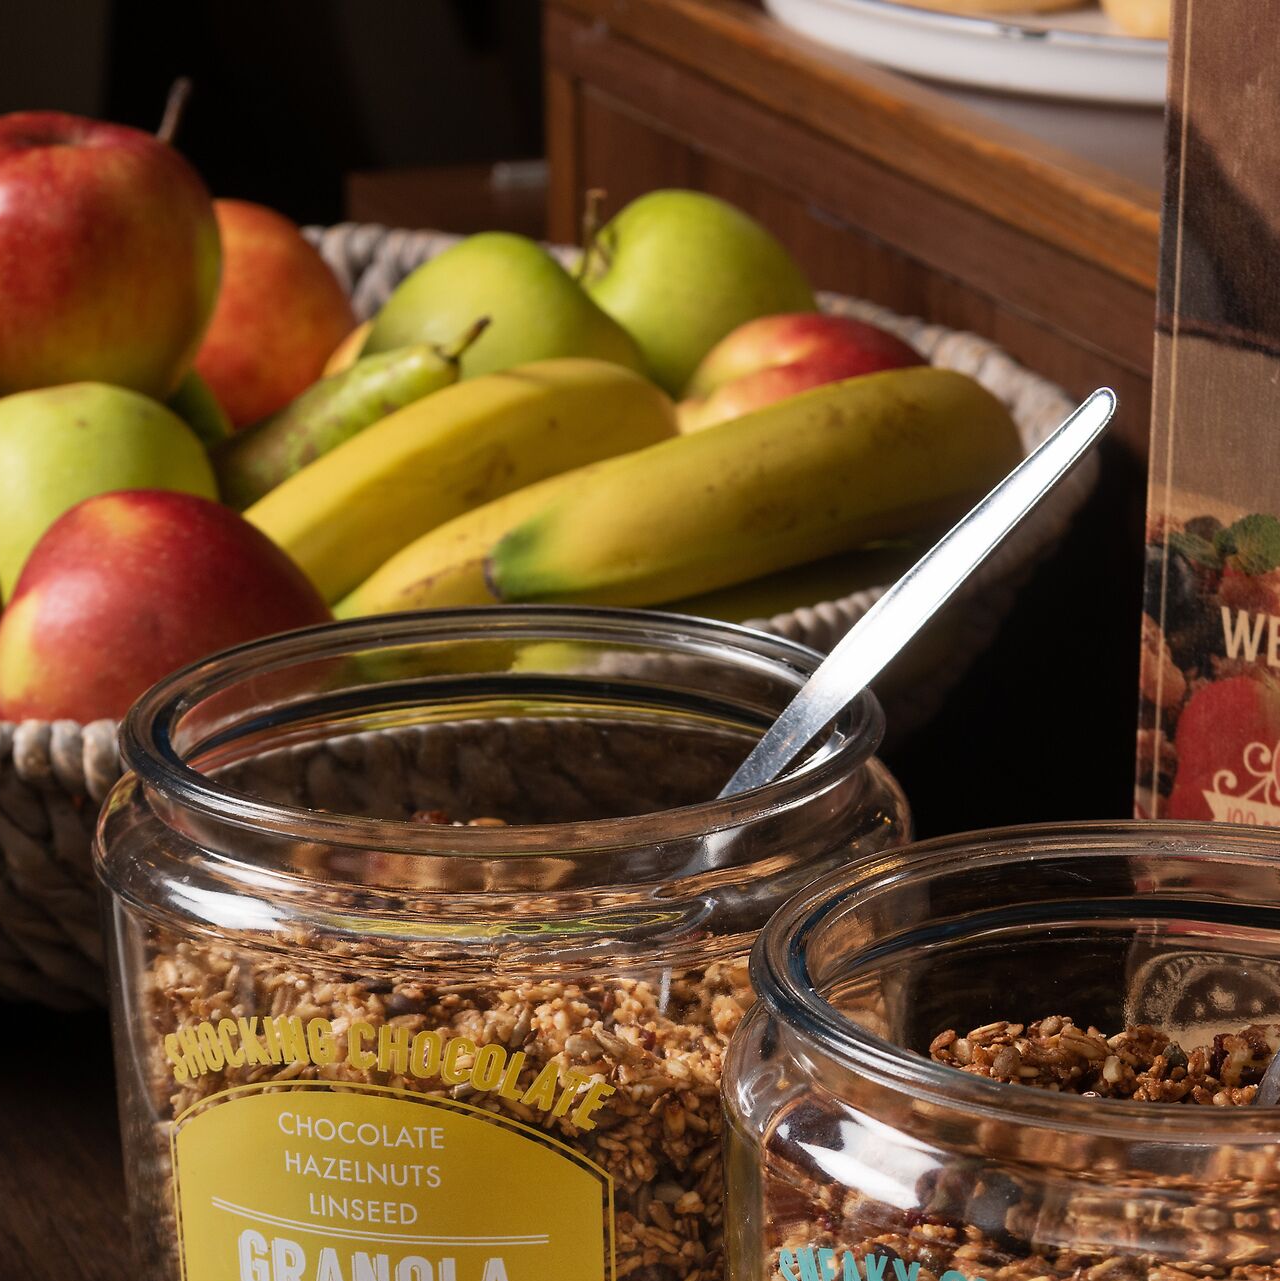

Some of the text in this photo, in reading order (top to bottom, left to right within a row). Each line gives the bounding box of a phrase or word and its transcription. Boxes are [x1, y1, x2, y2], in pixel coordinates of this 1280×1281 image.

[164, 1014, 617, 1131] SHOCKING CHOCOLATE
[278, 1111, 445, 1150] CHOCOLATE
[285, 1149, 442, 1189] HAZELNUTS
[308, 1191, 418, 1225] LINSEED
